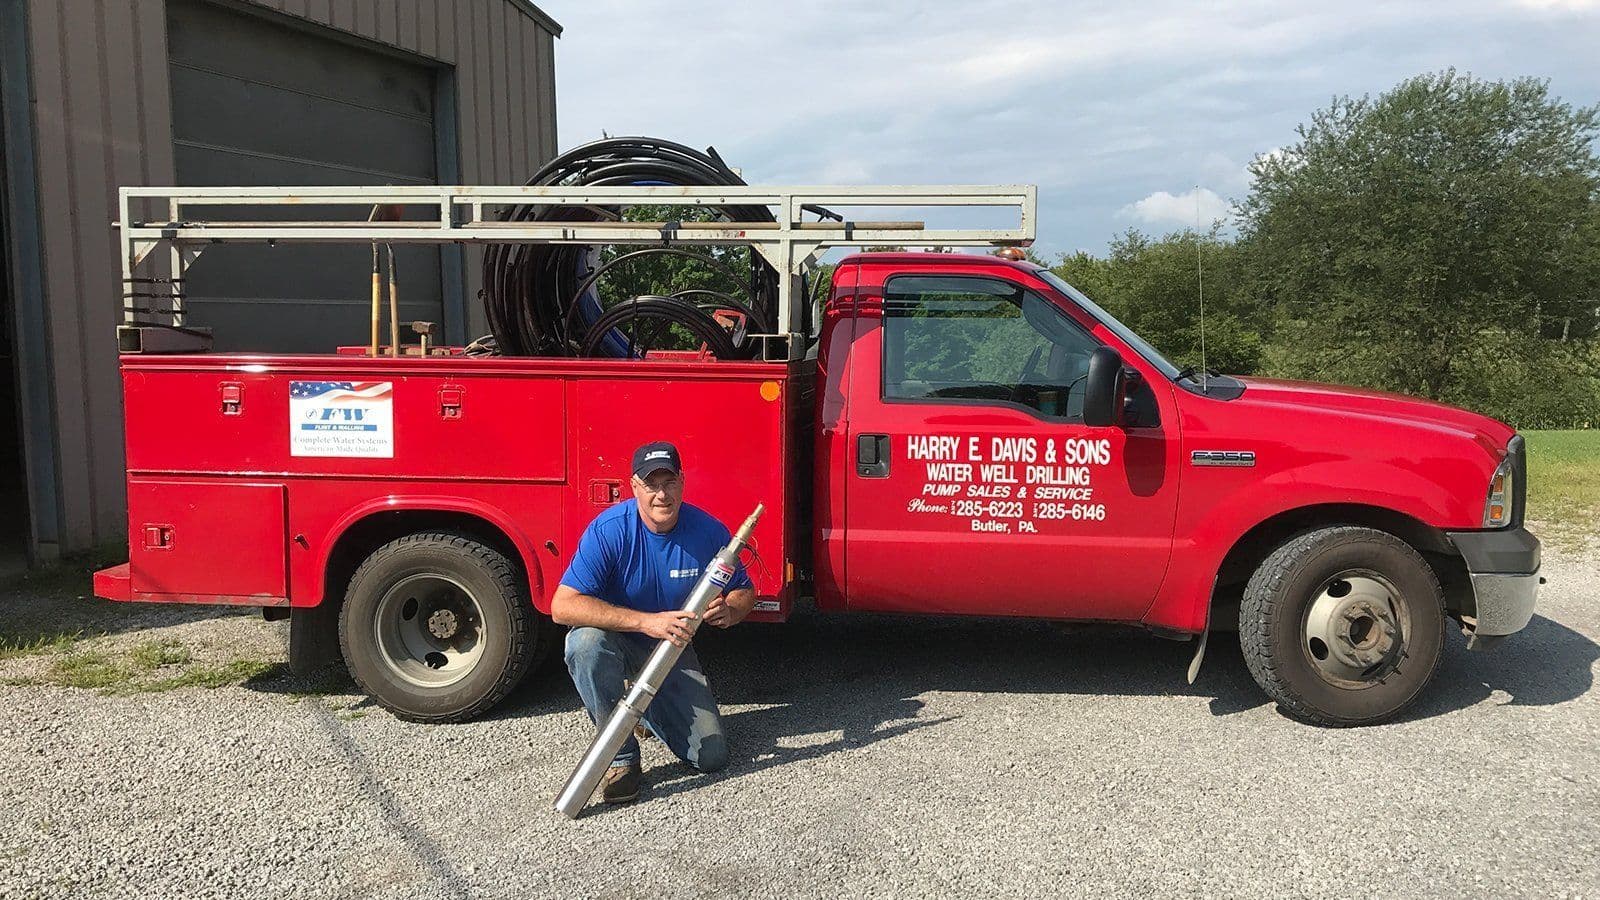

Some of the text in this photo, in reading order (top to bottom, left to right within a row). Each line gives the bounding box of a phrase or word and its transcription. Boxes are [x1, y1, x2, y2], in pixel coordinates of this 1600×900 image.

[907, 435, 1110, 465] HARRY E. DAVIS & SONS
[926, 463, 1090, 485] WATER WELL DRILLING
[922, 484, 1093, 500] PUMP SALES & SERVICE
[907, 498, 948, 513] Phone:
[957, 500, 1023, 518] 285-6223
[1038, 502, 1105, 521] 285-6146
[971, 519, 1039, 534] Butler, PA.
